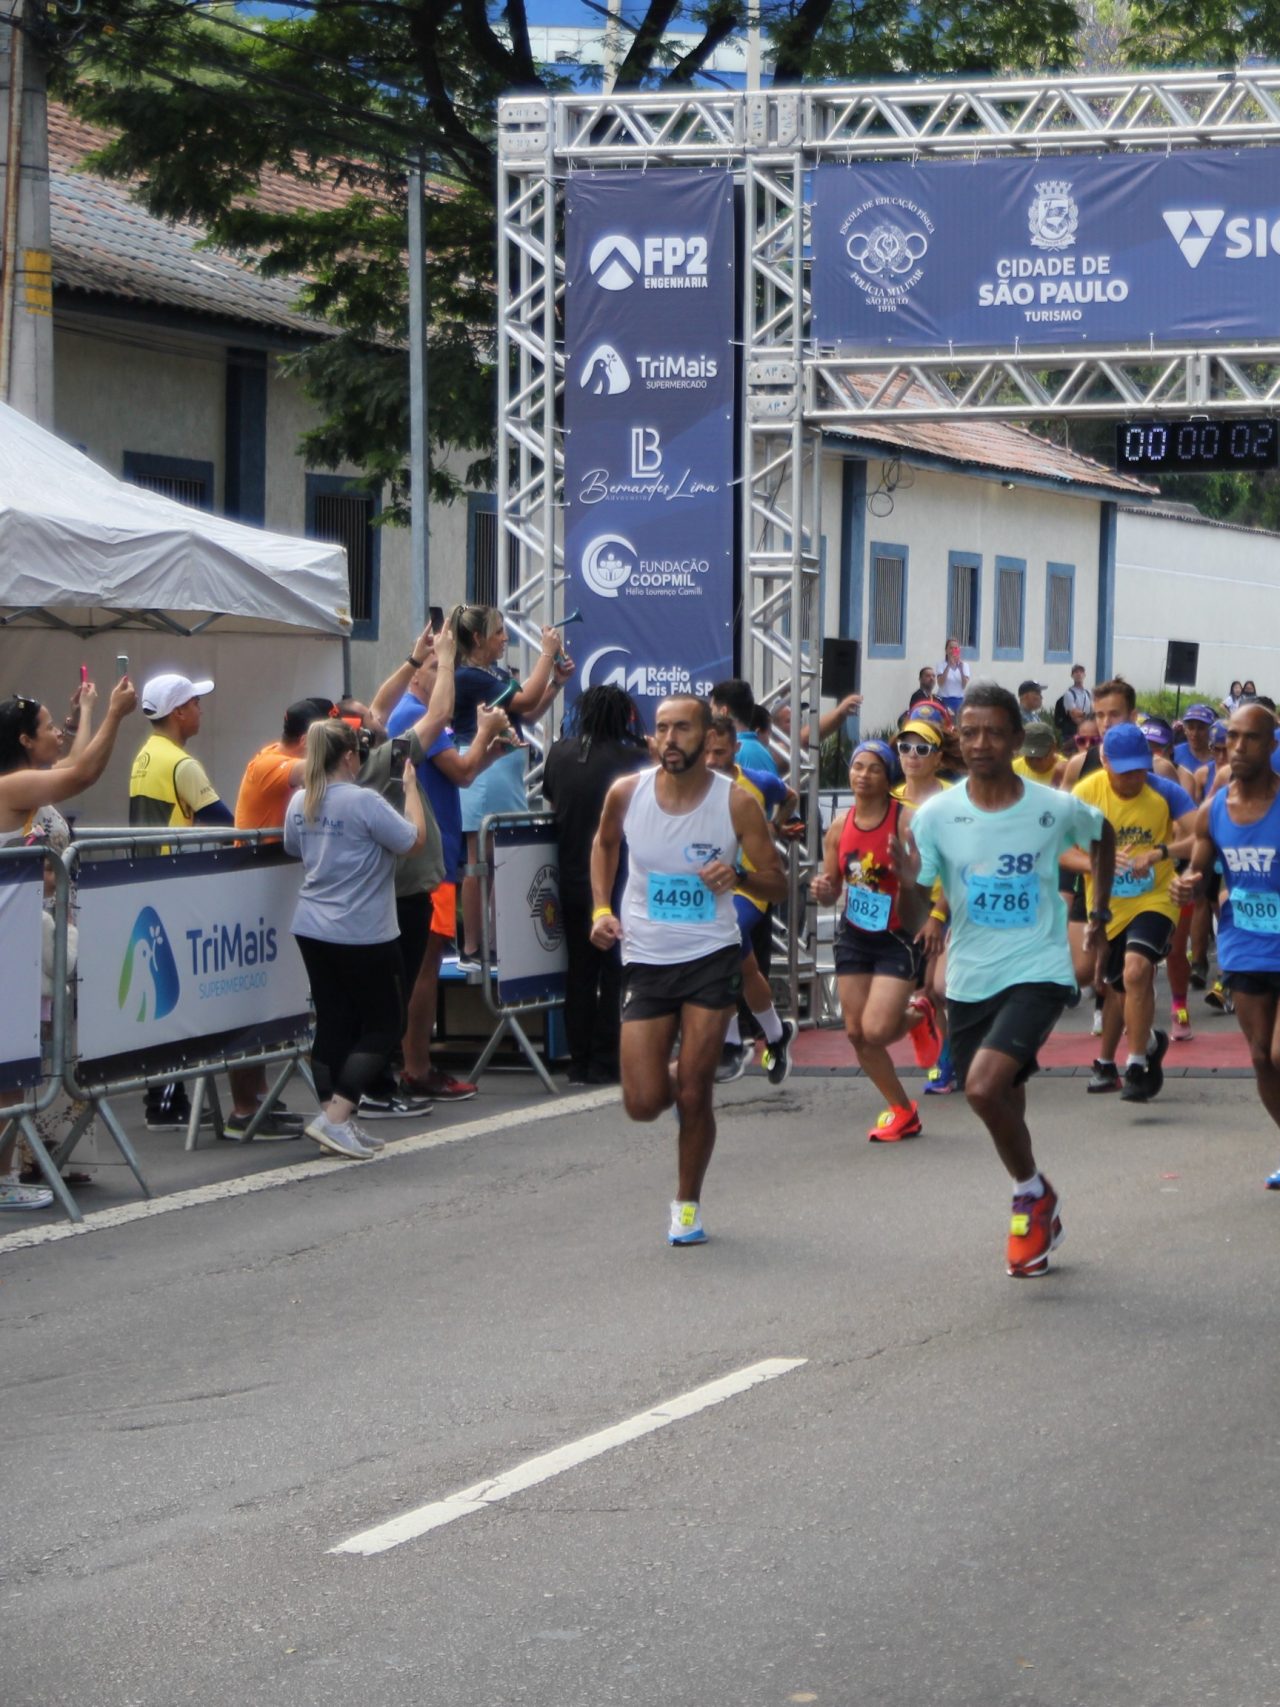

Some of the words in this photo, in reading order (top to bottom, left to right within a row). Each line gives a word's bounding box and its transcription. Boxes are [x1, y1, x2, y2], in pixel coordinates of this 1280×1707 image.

[840, 207, 863, 236] ESCOLA
[862, 201, 874, 211] DE
[875, 197, 918, 213] EDUCAÇÃO
[916, 209, 935, 235] FÍSICA
[644, 237, 708, 275] FP2
[996, 257, 1076, 278] CIDADE
[1082, 256, 1110, 275] DE
[644, 276, 709, 289] ENGENHARIA
[886, 268, 924, 296] MILITAR
[865, 296, 880, 305] SÃO
[883, 297, 909, 305] PAULO
[978, 279, 1035, 306] SÃO
[1040, 279, 1129, 304] PAULO
[1024, 310, 1082, 322] TURISMO
[636, 355, 717, 378] TriMais
[646, 380, 708, 389] SUPERMERCADO
[579, 469, 670, 503] Bernardes
[666, 468, 719, 500] Lima
[640, 558, 709, 574] FUNDAÇÃO
[630, 574, 696, 587] COOPMIL
[626, 587, 644, 596] Hélio
[646, 587, 676, 597] Lourenço
[678, 587, 703, 596] Camilli
[648, 665, 690, 681] Rádio
[670, 683, 692, 695] FM
[695, 682, 714, 697] SP
[653, 888, 704, 907] 4490
[974, 891, 1030, 912] 4786
[1237, 901, 1277, 918] 4080
[186, 916, 278, 976] TriMais
[199, 971, 268, 1000] SUPERMERCADO
